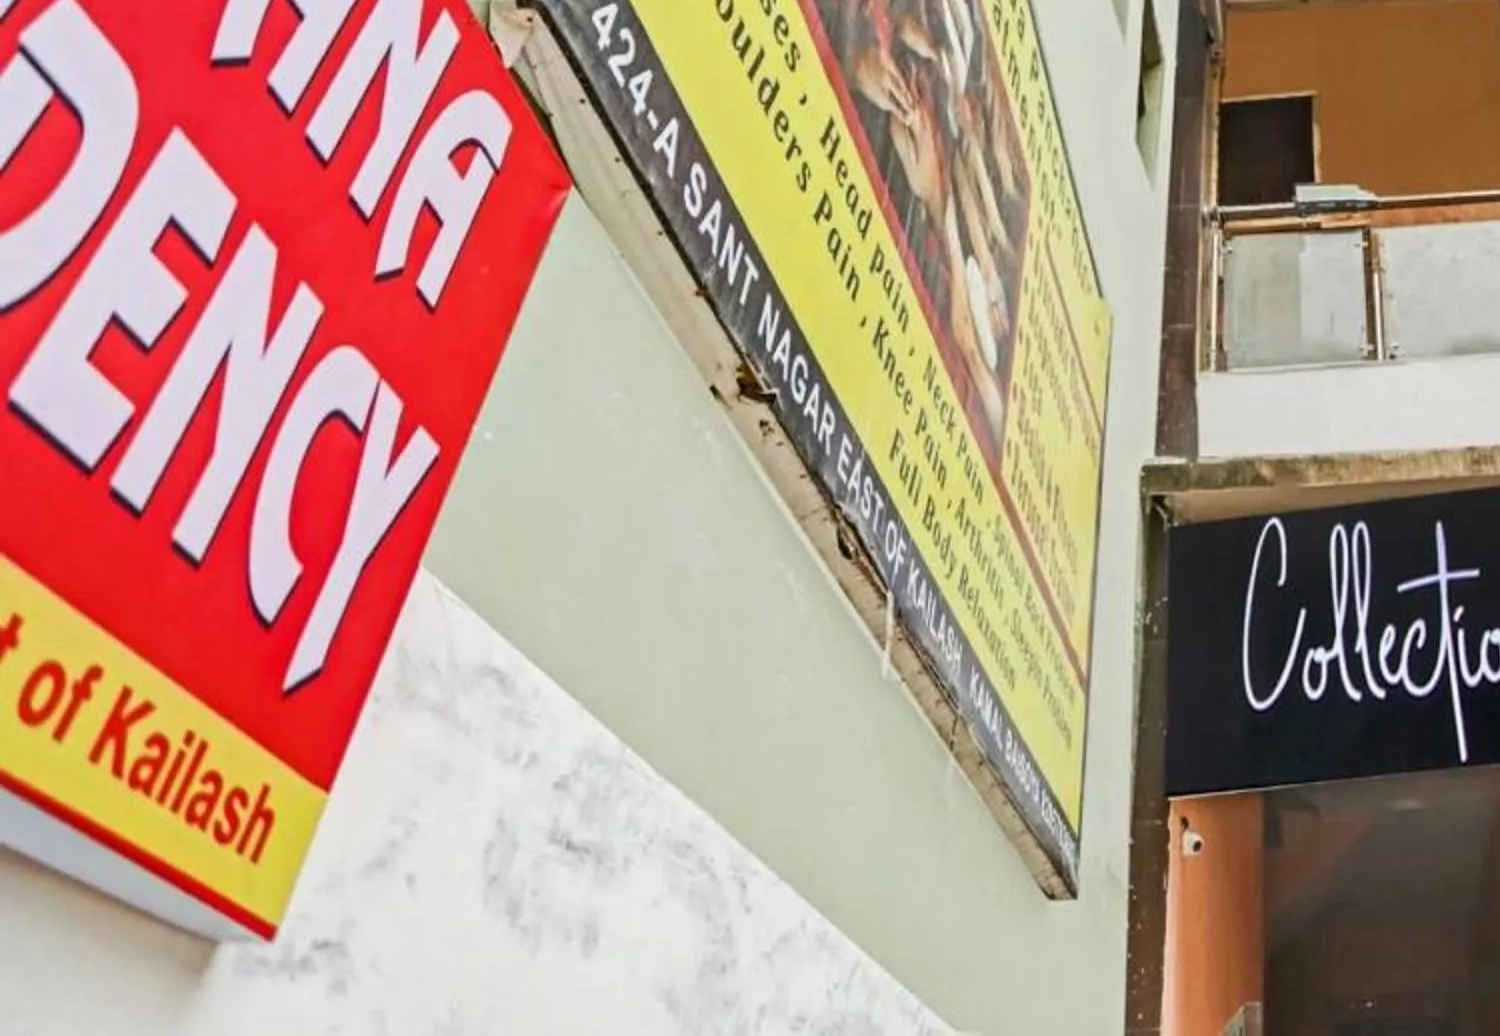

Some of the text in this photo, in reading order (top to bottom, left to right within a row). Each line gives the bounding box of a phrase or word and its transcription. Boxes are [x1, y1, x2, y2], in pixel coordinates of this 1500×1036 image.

[591, 3, 679, 177] 424-A
[683, 162, 759, 298] SANT
[757, 294, 835, 448] NAGAR
[836, 433, 884, 528] EAST
[884, 519, 907, 575] OF
[906, 559, 963, 679] KAILASH
[819, 116, 873, 239] Head
[922, 355, 956, 441] Neck
[871, 316, 913, 414] Knee
[18, 659, 104, 742] of
[88, 684, 276, 865] Kailash
